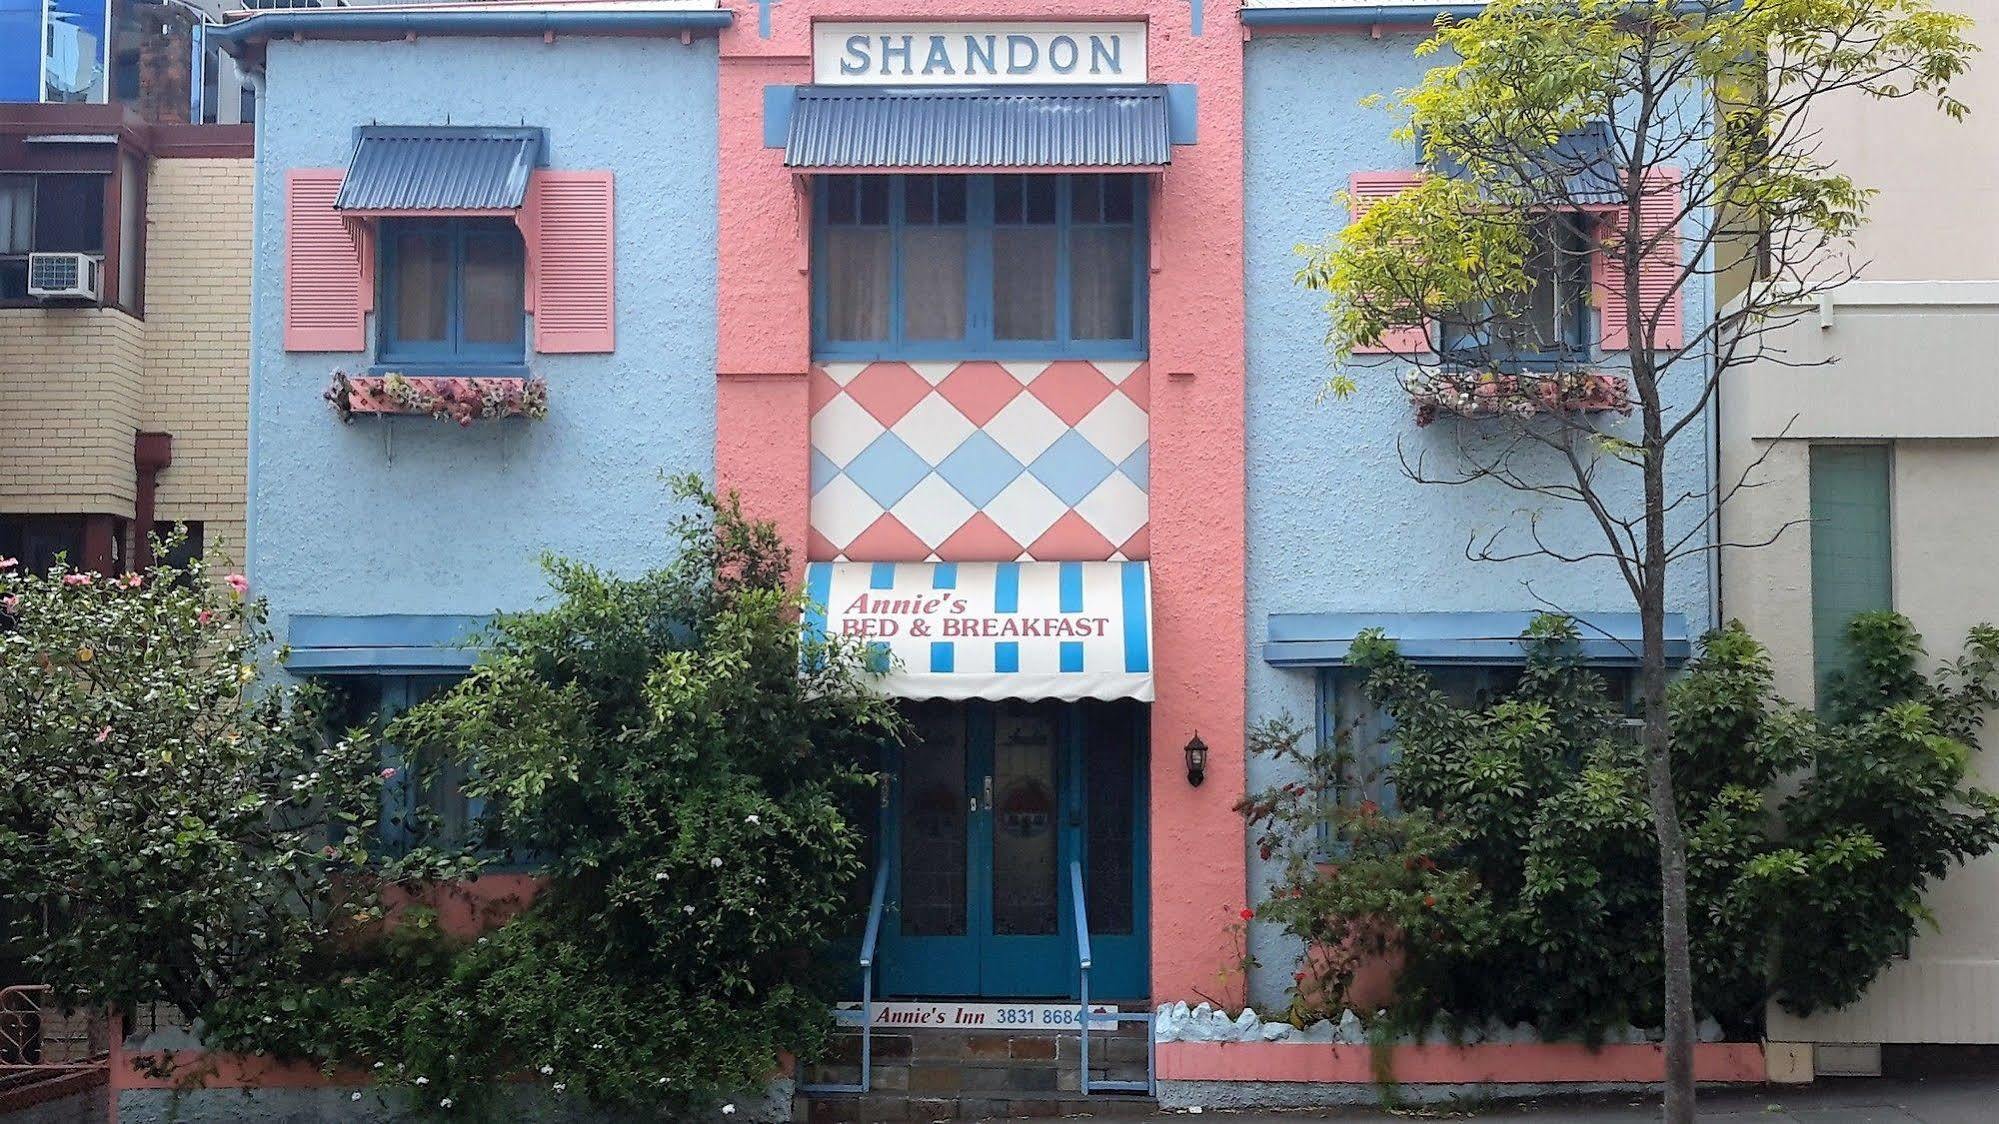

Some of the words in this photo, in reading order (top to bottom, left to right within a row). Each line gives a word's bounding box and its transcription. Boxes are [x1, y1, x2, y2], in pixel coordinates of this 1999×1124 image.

[840, 34, 1122, 75] SHANDON
[844, 592, 967, 615] Annie's
[842, 618, 899, 637] BED
[909, 618, 932, 638] &
[942, 618, 1110, 638] BREAKFAST
[875, 1006, 946, 1025] Annie's
[954, 1007, 986, 1025] Inn
[996, 1008, 1034, 1024] 3831
